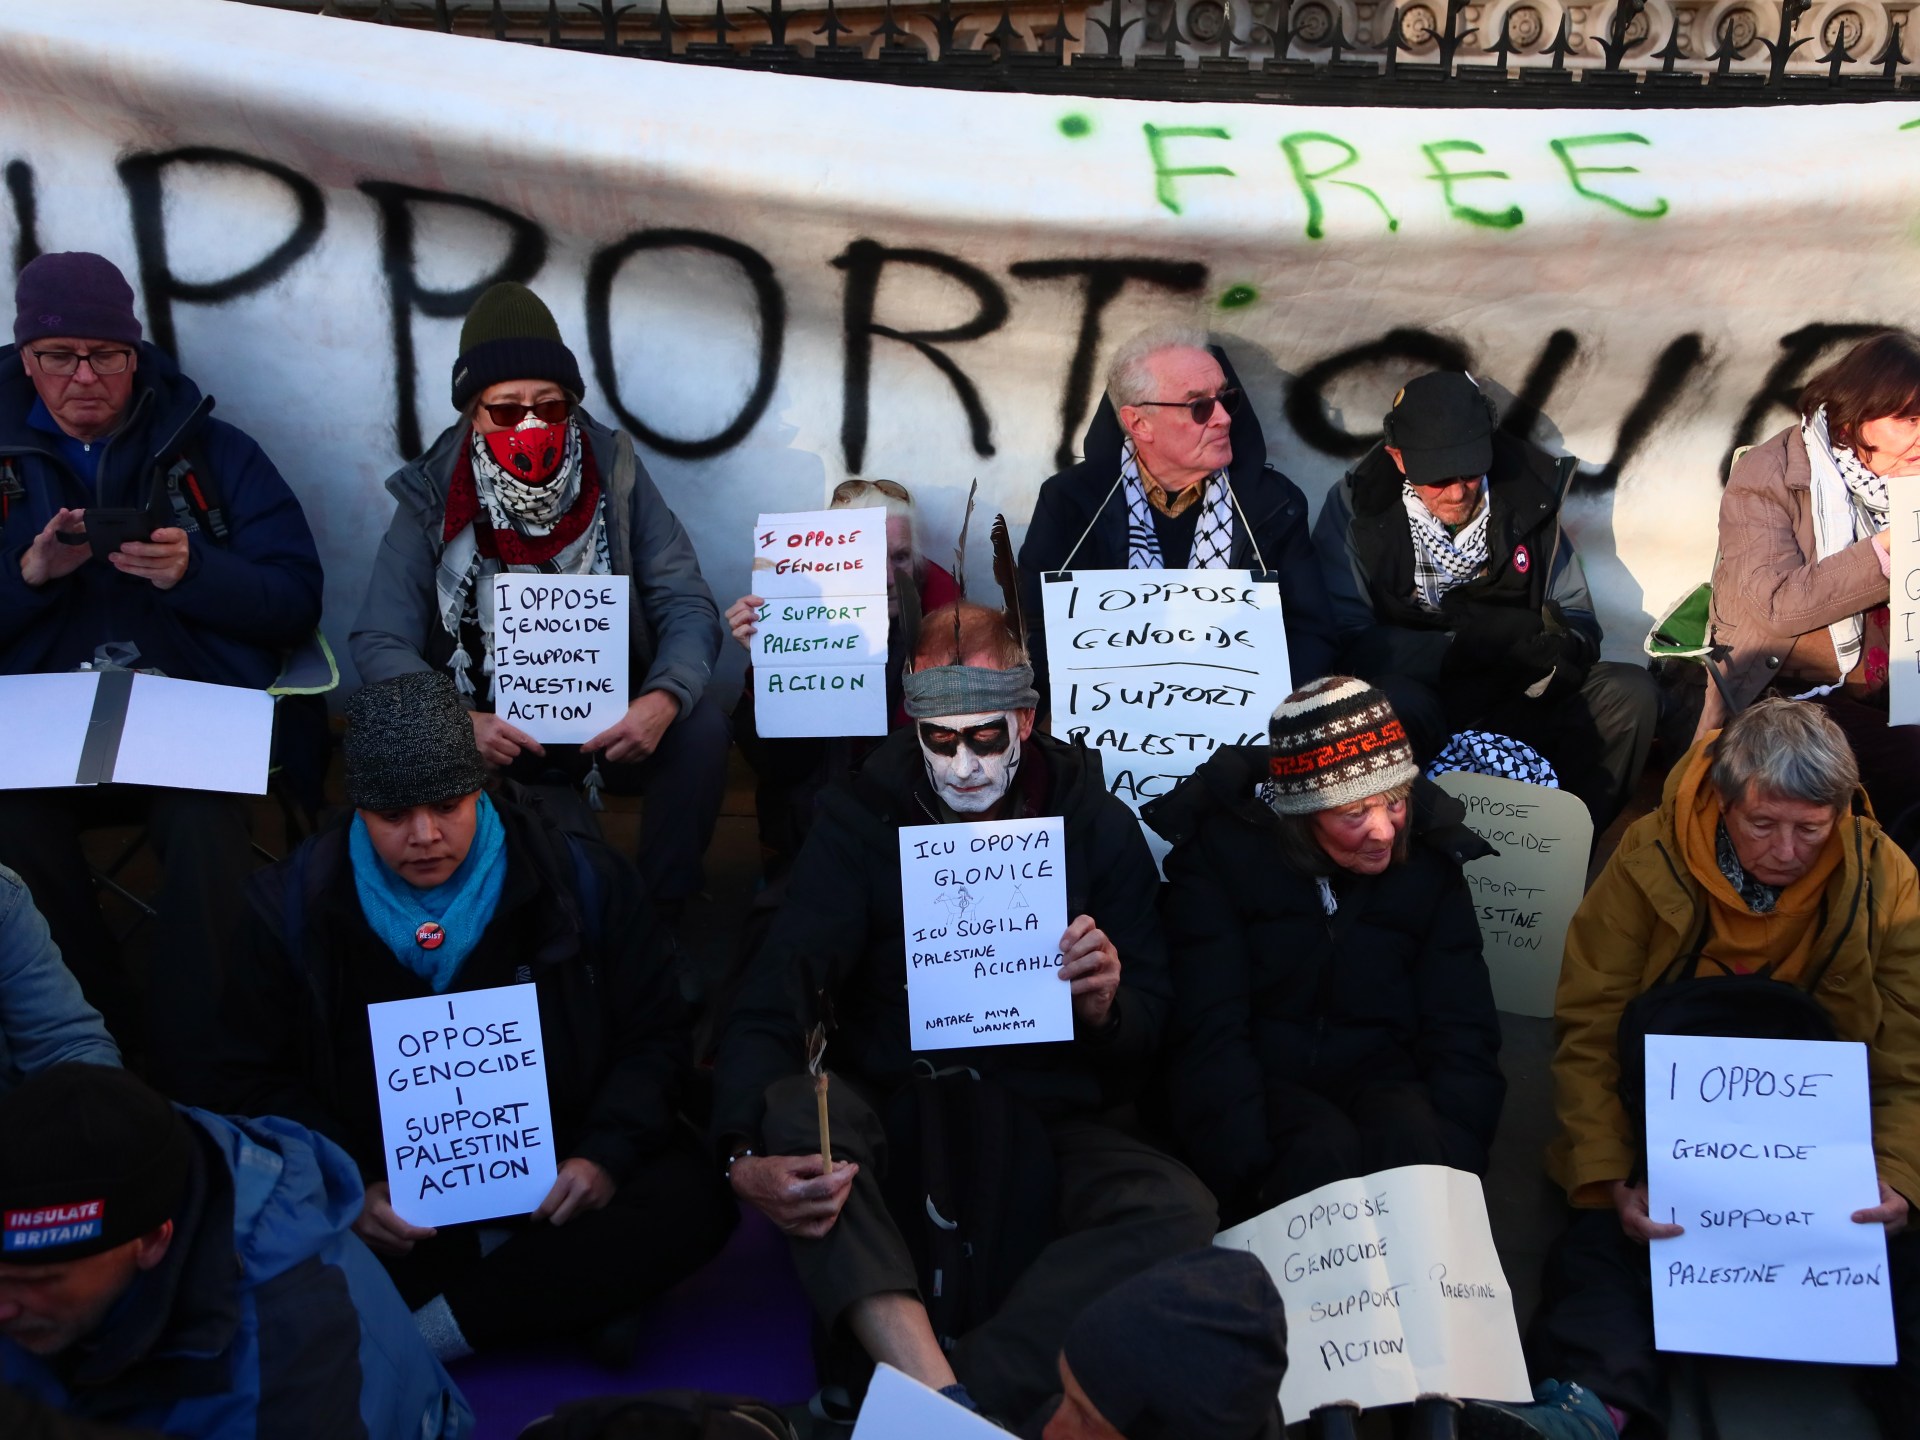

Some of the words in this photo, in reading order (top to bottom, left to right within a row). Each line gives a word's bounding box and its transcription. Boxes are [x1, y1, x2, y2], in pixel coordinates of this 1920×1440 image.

[1143, 121, 1668, 239] FREE
[5, 146, 1208, 474] PPORT
[758, 531, 777, 549] I
[787, 530, 863, 548] OPPOSE
[775, 558, 864, 575] GENOCIDE
[496, 584, 511, 611] I
[520, 587, 617, 610] OPPOSE
[1067, 586, 1079, 619] I
[1099, 583, 1260, 611] OPPOSE
[758, 603, 772, 623] I
[782, 605, 867, 621] SUPPORT
[502, 617, 610, 645] GENOCIDE
[763, 634, 860, 654] PALESTINE
[1072, 622, 1256, 650] GENOCIDE
[496, 646, 508, 666] I
[512, 648, 600, 667] SUPPORT
[499, 674, 615, 694] PALESTINE
[768, 674, 865, 692] ACTION
[1069, 683, 1078, 715] I
[1092, 681, 1256, 711] SUPPORT
[507, 702, 591, 721] ACTION
[914, 841, 955, 859] ICU
[970, 830, 1050, 852] OPOYA
[1469, 827, 1560, 853] NOCIDE
[934, 860, 1053, 886] GLONICE
[913, 927, 947, 942] ICU
[957, 913, 1039, 937] SUGILA
[1479, 926, 1542, 950] TION
[912, 945, 996, 969] PALESTINE
[448, 1000, 455, 1020] I
[925, 1012, 974, 1030] NATAKE
[985, 1006, 1020, 1020] MIYA
[398, 1021, 522, 1058] OPPOSE
[973, 1019, 1036, 1034] WANKATA
[388, 1049, 537, 1092] GENOCIDE
[1670, 1062, 1677, 1100] I
[1700, 1066, 1833, 1102] OPPOSE
[455, 1086, 463, 1105] I
[406, 1102, 529, 1142] SUPPORT
[395, 1127, 541, 1170] PALESTINE
[1672, 1139, 1816, 1160] GENOCIDE
[419, 1156, 530, 1200] ACTION
[11, 1202, 100, 1227] INSULATE
[1287, 1192, 1389, 1240] OPPOSE
[1700, 1209, 1815, 1228] SUPPORT
[14, 1223, 94, 1246] BRITAIN
[1284, 1238, 1388, 1282] GENOCIDE
[1669, 1261, 1784, 1287] PALESTINE
[1802, 1264, 1881, 1287] ACTION
[1309, 1283, 1410, 1322] SUPPORT
[1320, 1338, 1404, 1371] ACTION
